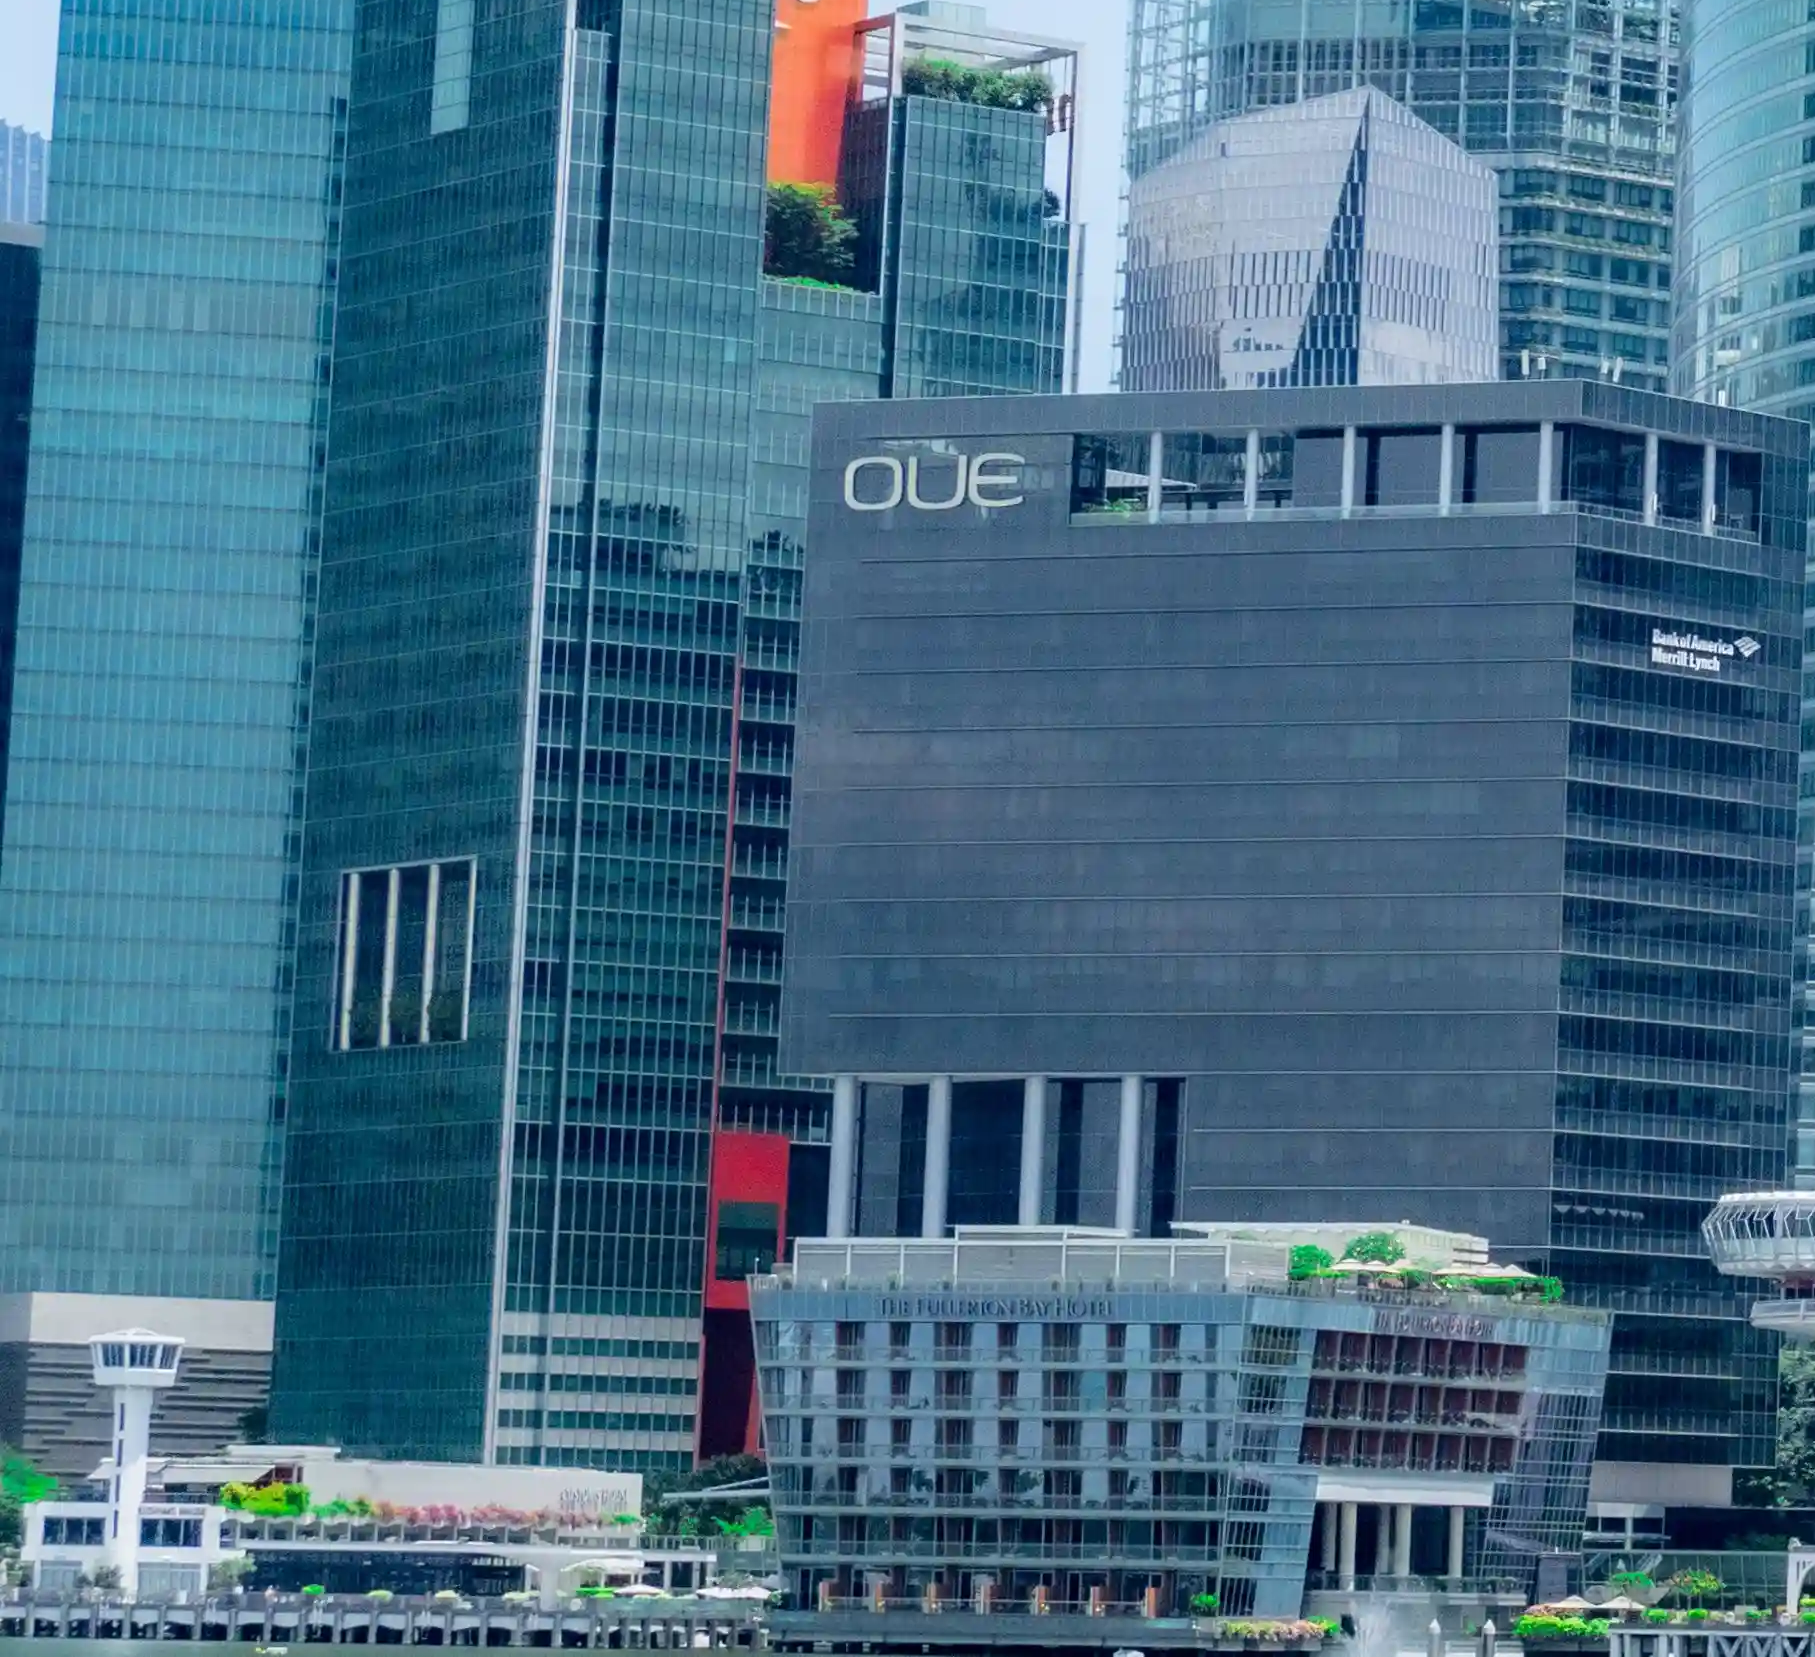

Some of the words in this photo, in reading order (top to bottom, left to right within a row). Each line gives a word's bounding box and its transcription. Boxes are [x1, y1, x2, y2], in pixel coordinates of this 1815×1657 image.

[844, 452, 1025, 510] OUE
[1652, 628, 1679, 647] Bank
[1680, 633, 1692, 648] of
[1691, 635, 1734, 656] America
[1652, 647, 1688, 667] Merrill
[1689, 653, 1720, 671] Lynch
[880, 1297, 909, 1317] THE
[915, 1297, 1017, 1317] FULLERTON
[1018, 1297, 1052, 1317] BAY
[1056, 1297, 1113, 1318] HOTEL
